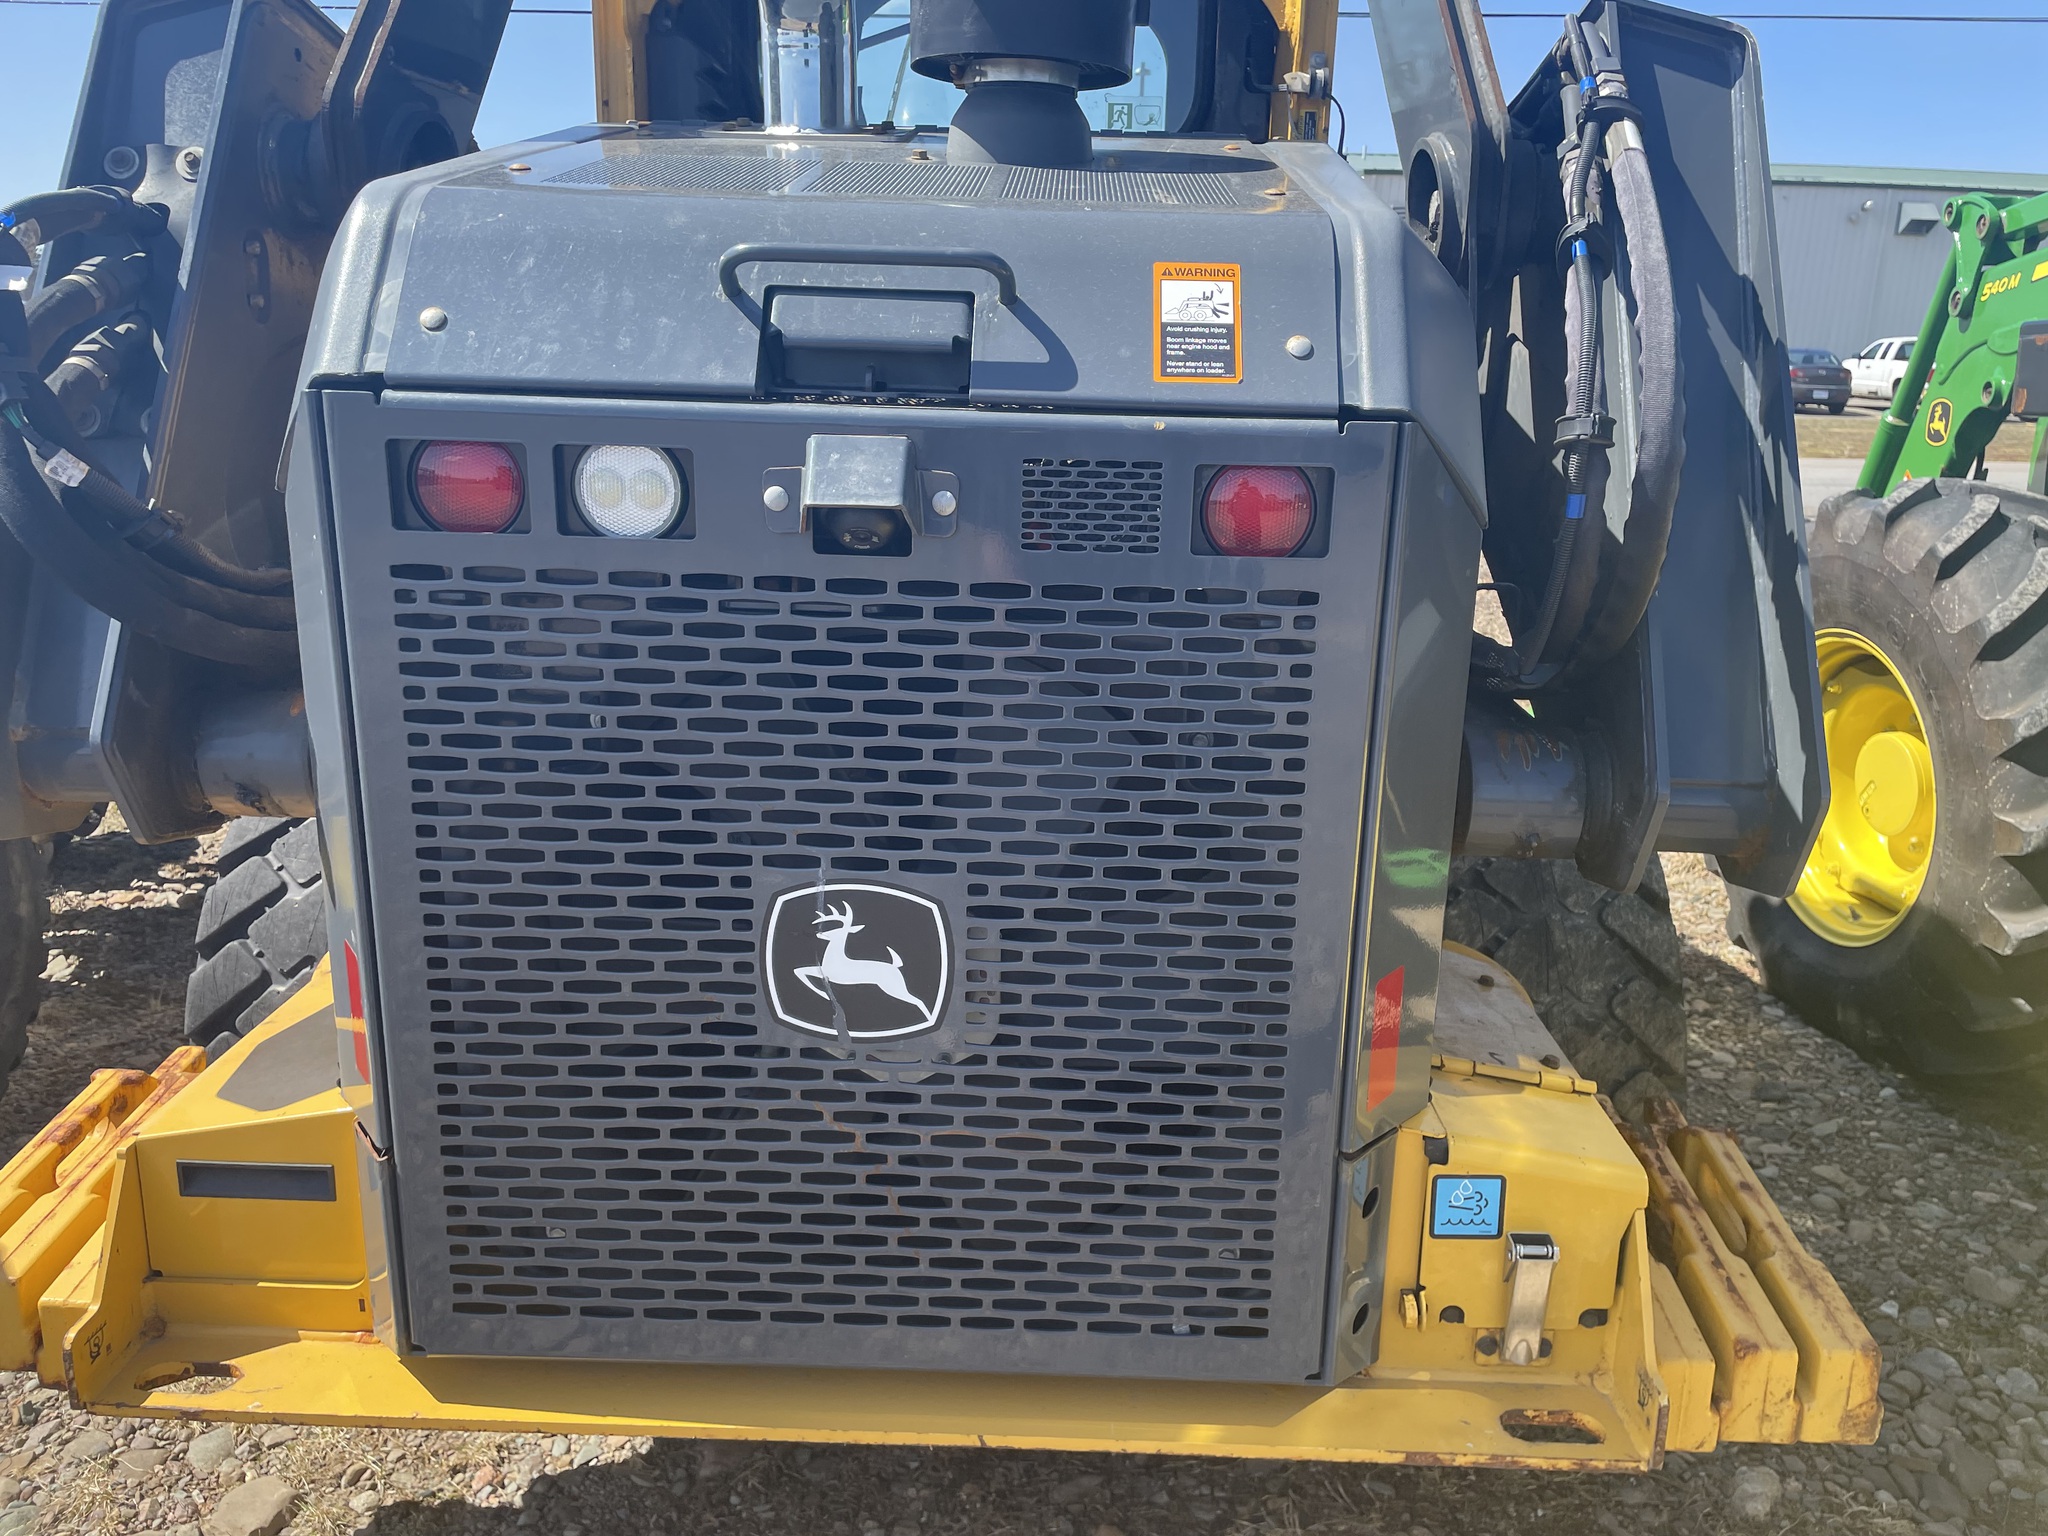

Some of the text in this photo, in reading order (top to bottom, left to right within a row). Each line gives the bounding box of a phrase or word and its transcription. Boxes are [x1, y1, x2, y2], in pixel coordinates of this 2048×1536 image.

[1174, 267, 1236, 278] WARNING
[1980, 272, 2021, 301] 540M
[1184, 326, 1210, 334] crushing
